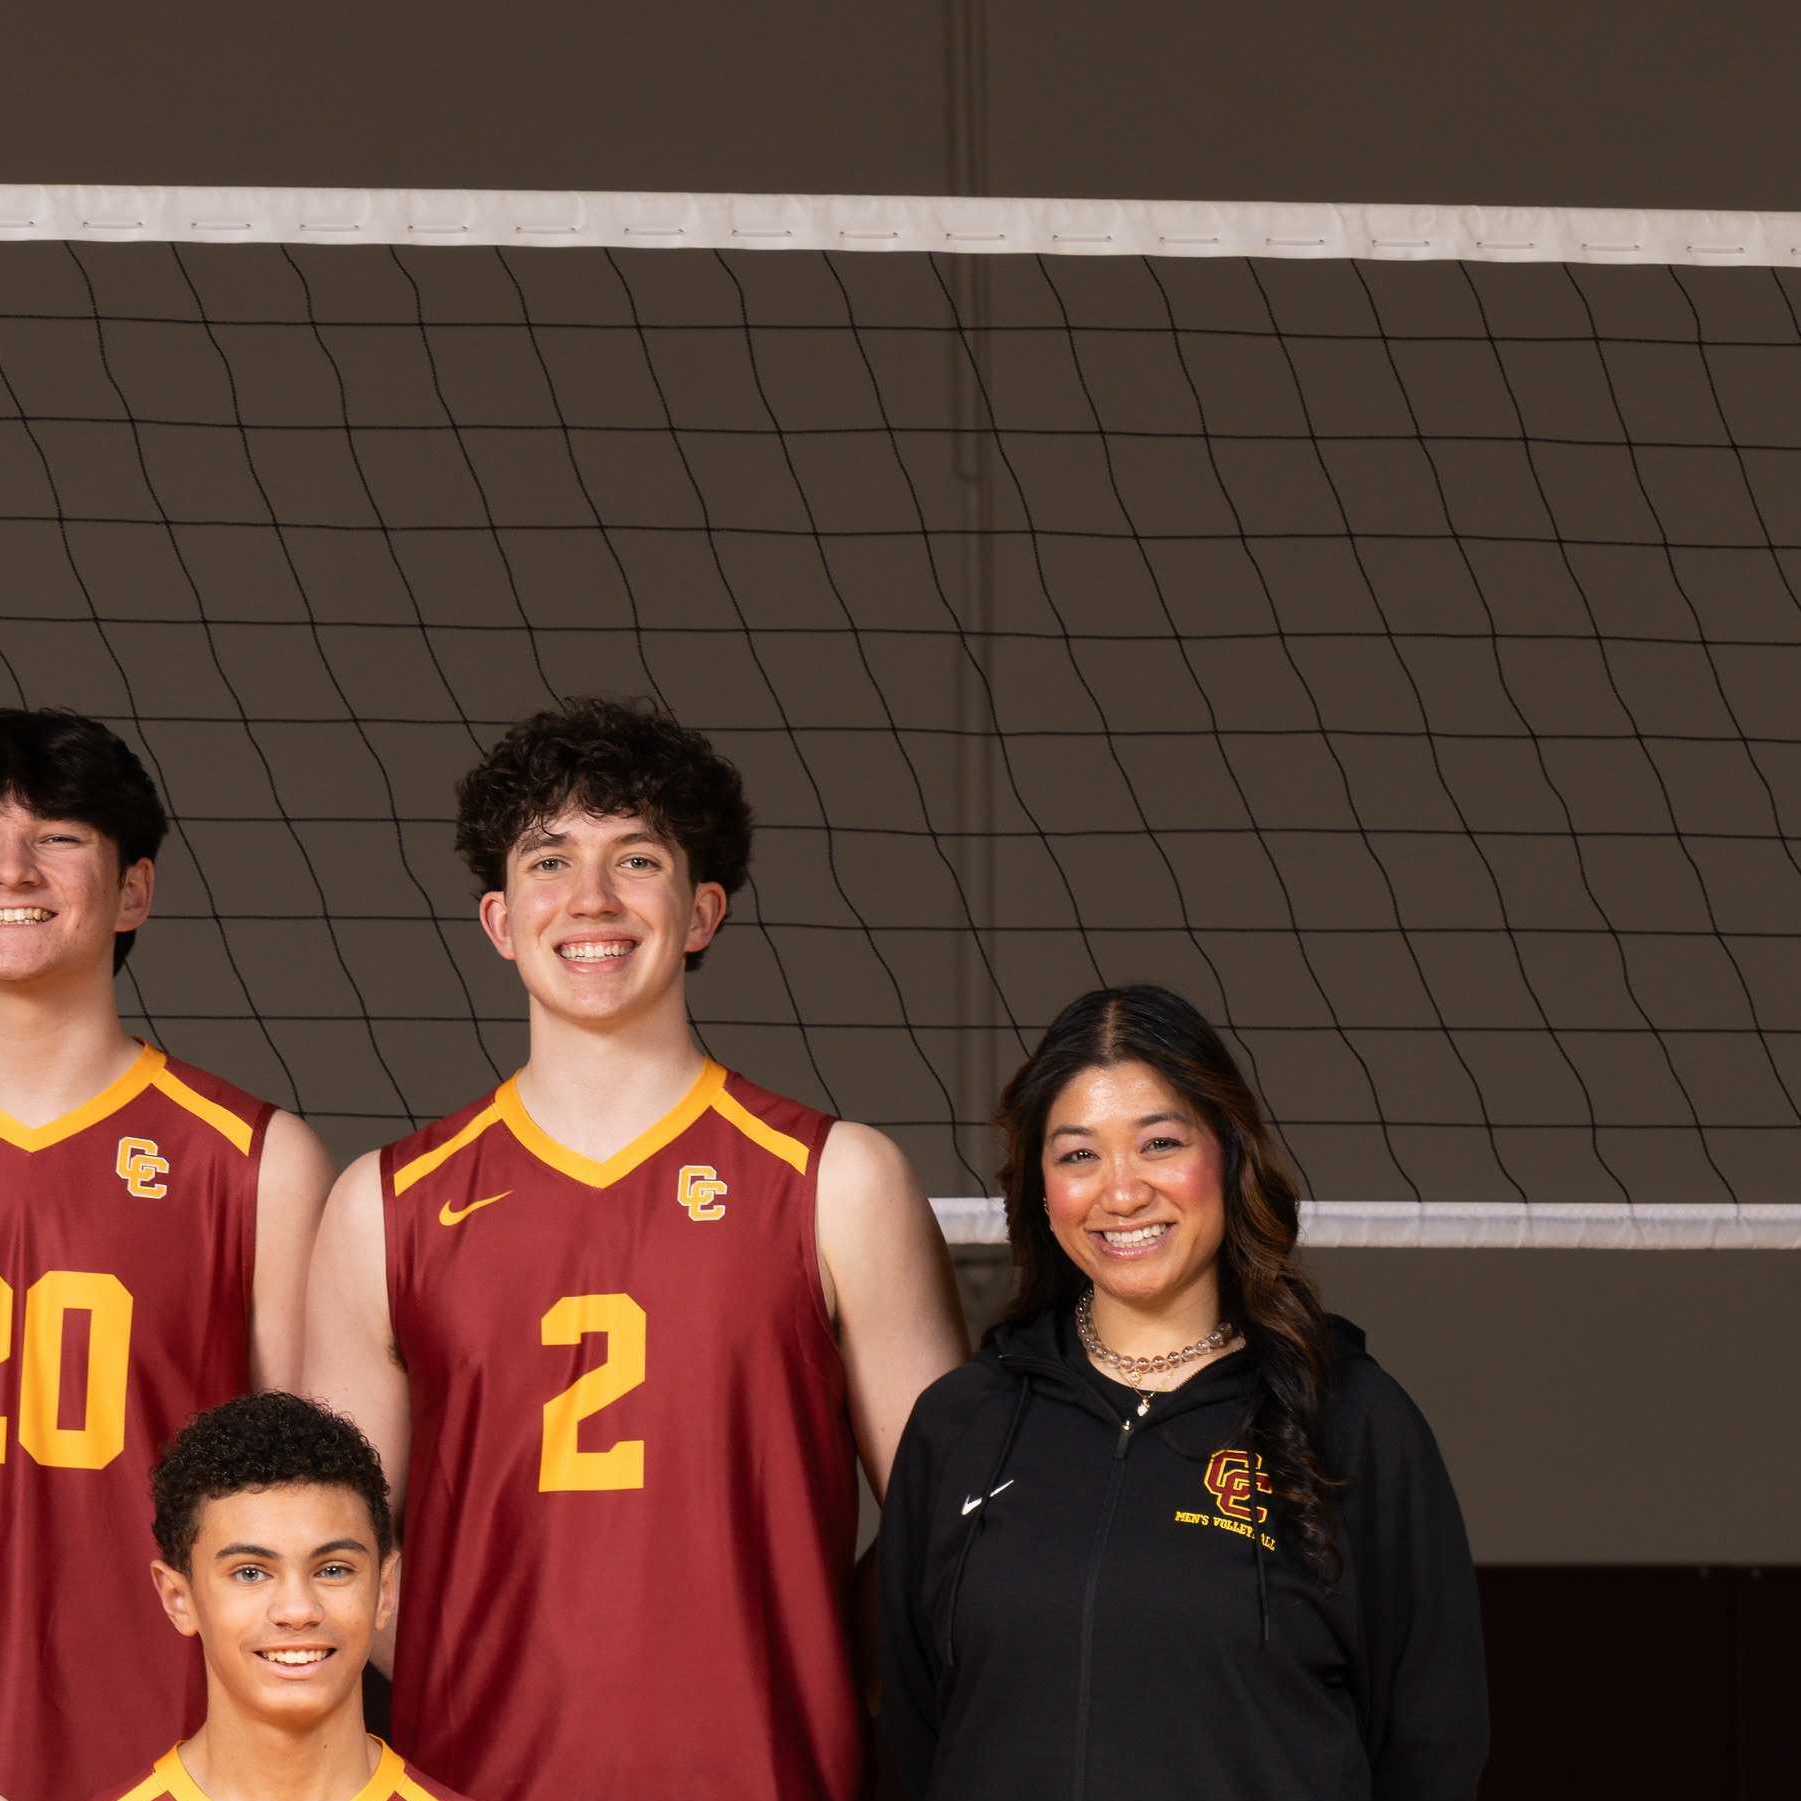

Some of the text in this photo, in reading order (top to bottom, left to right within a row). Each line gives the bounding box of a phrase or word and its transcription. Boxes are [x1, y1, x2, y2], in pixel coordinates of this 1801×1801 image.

[538, 1291, 648, 1494] 2
[1174, 1511, 1276, 1551] MEN'S VOLLEYLL
